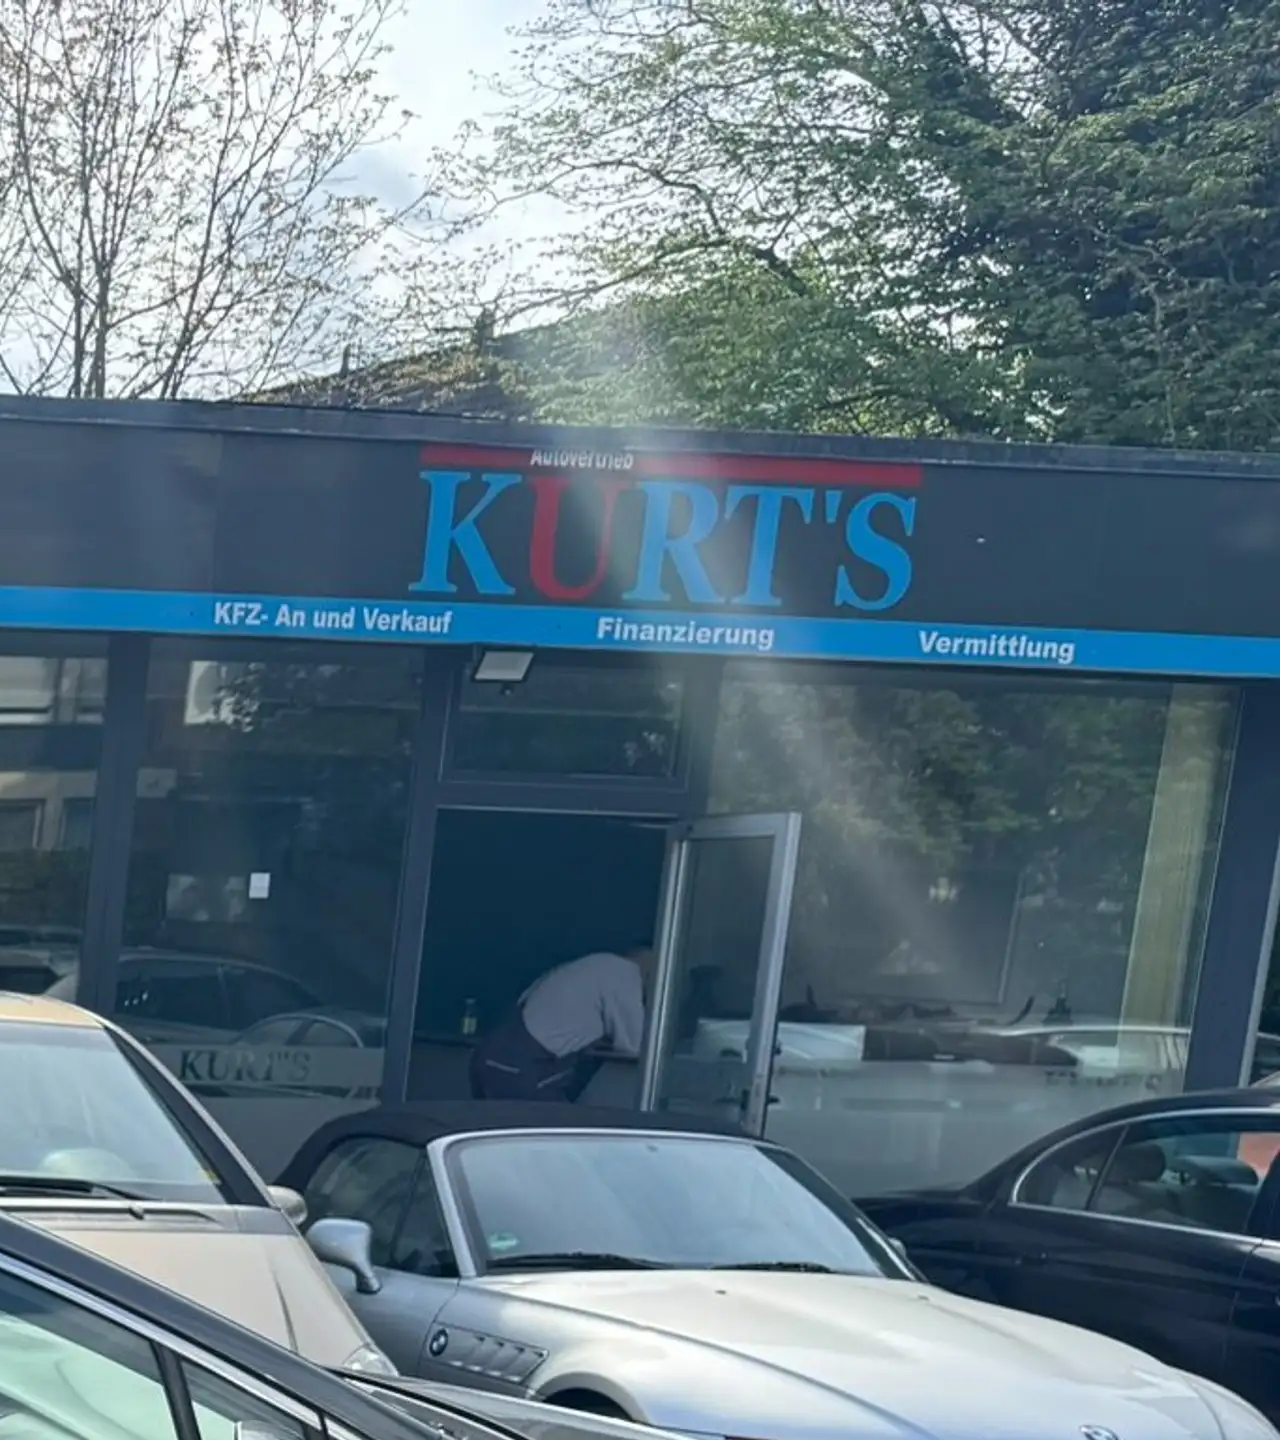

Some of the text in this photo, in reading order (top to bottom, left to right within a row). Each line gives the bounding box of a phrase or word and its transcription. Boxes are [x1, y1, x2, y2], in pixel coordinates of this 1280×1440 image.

[408, 470, 917, 611] KURT'S
[214, 602, 453, 634] KFZ- An und Verkauf
[596, 616, 775, 651] Finanzierung
[918, 630, 1075, 665] Vermittlung
